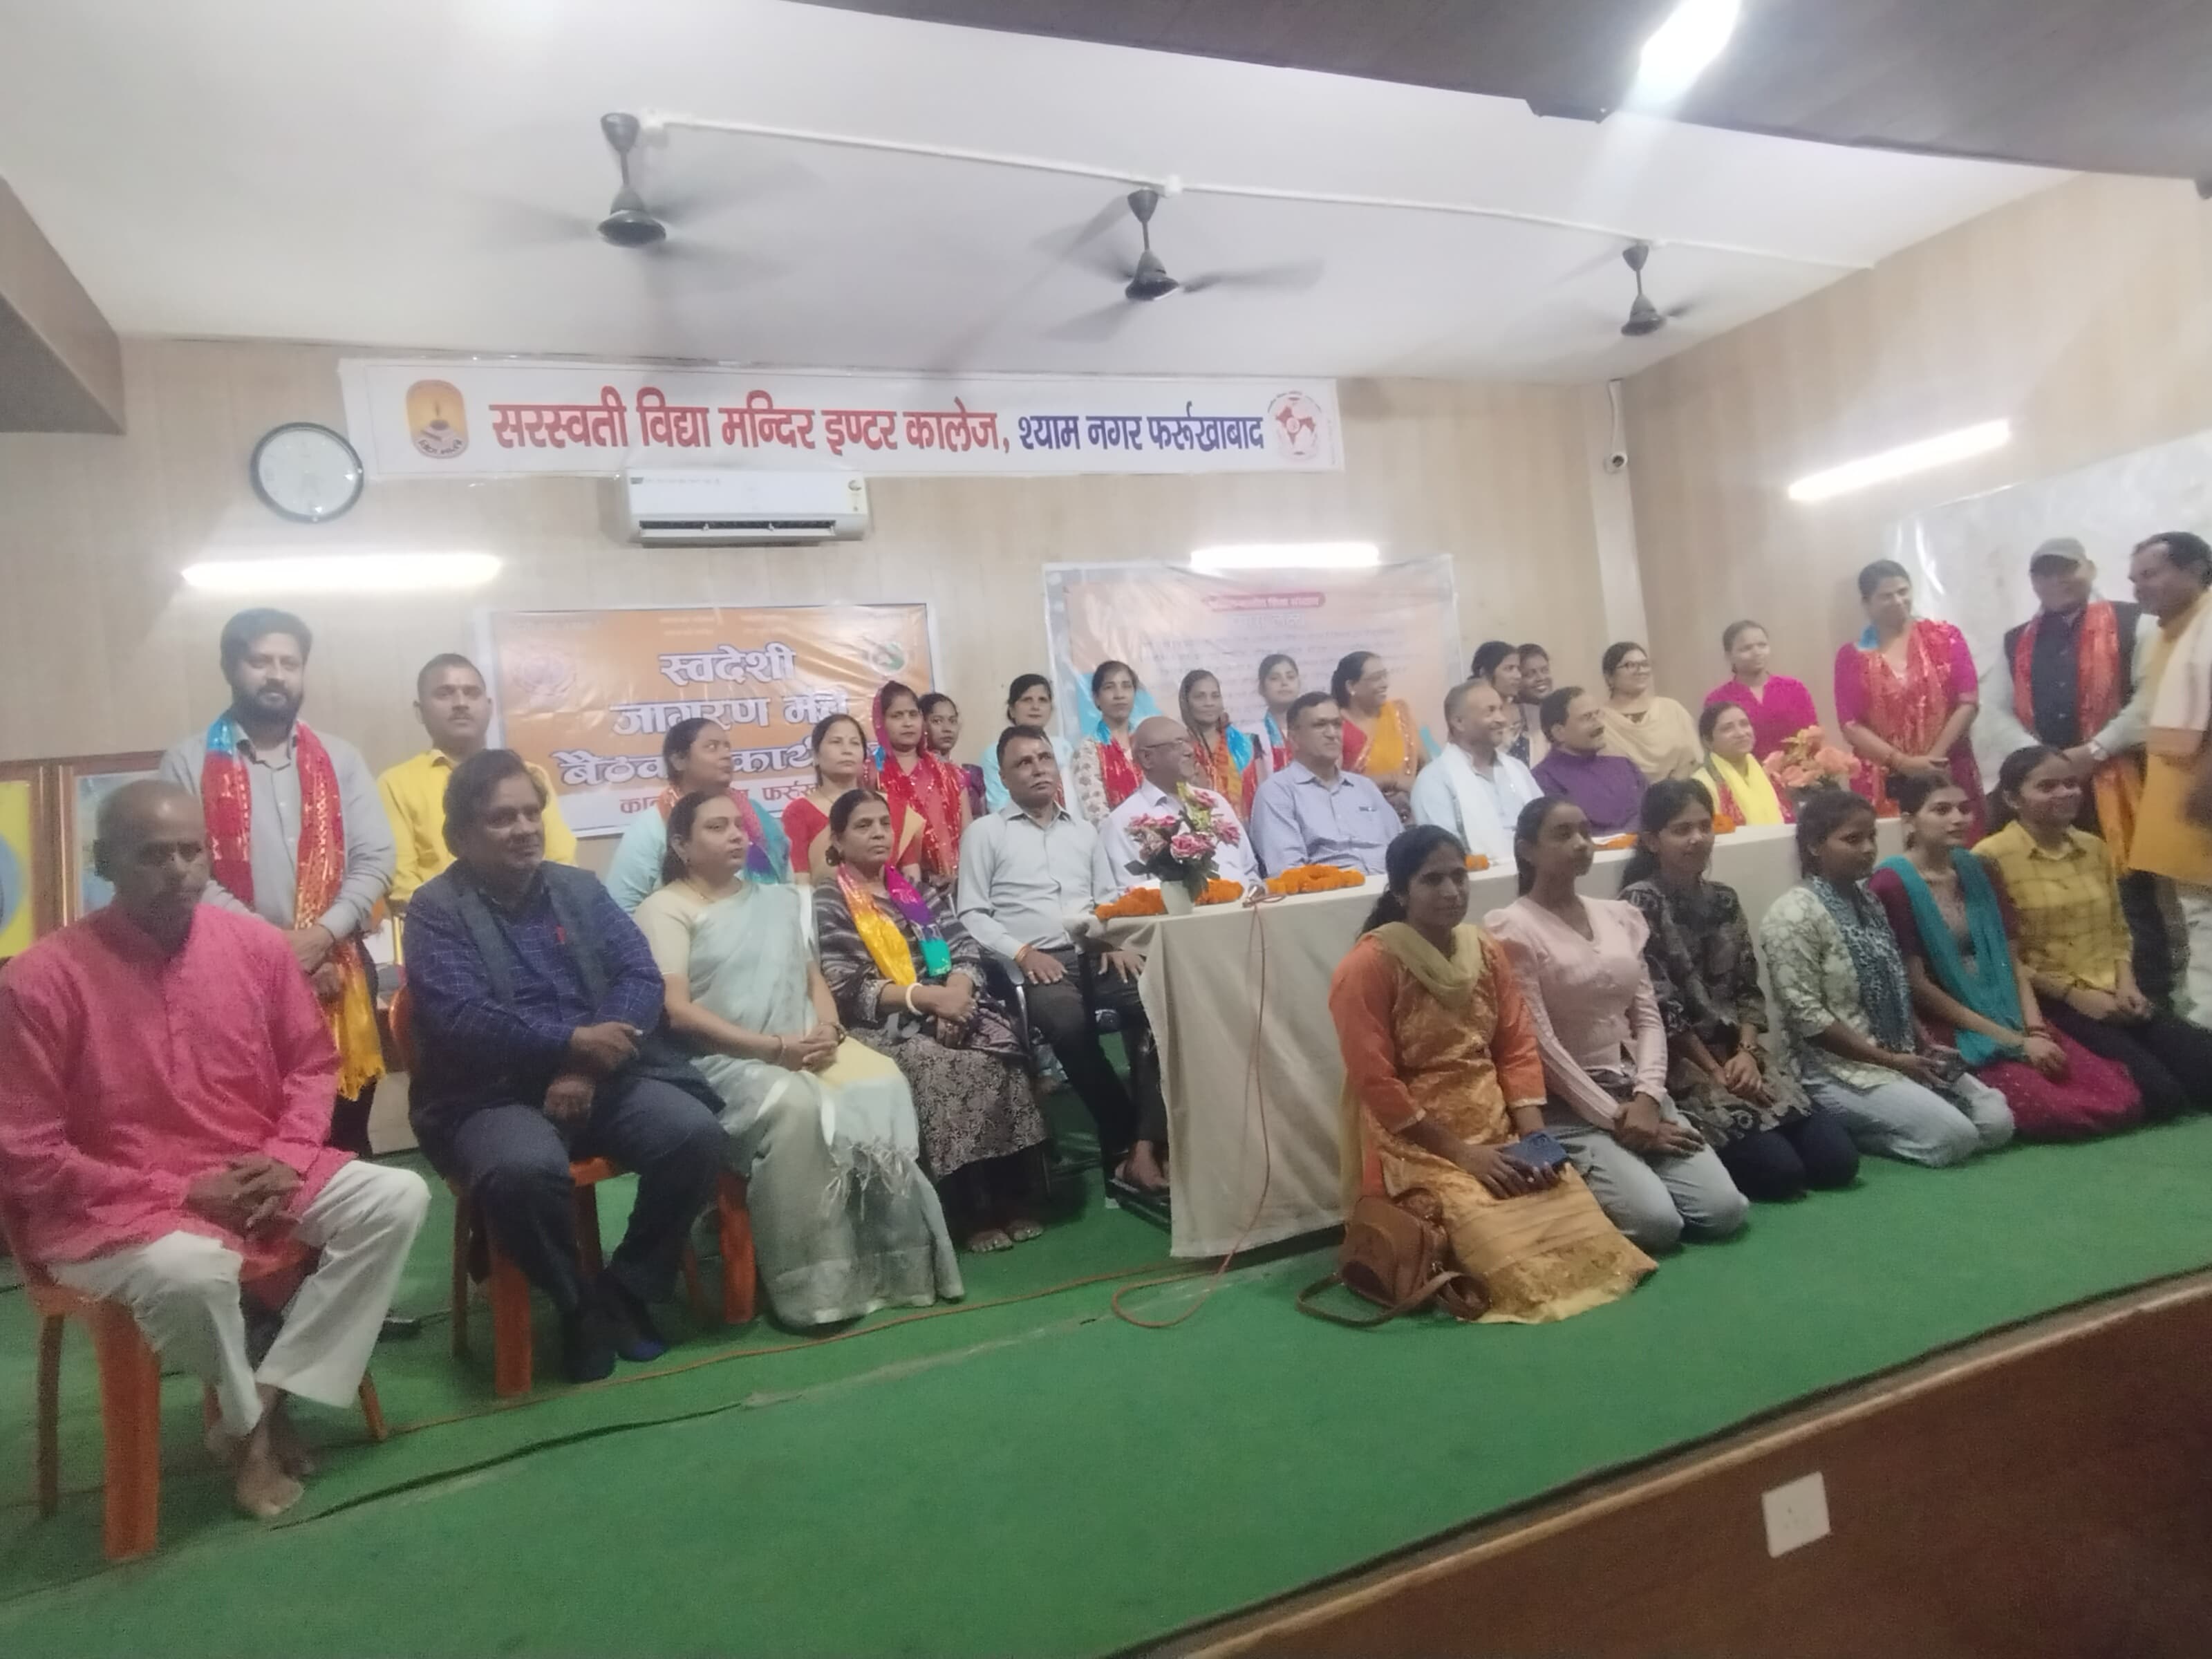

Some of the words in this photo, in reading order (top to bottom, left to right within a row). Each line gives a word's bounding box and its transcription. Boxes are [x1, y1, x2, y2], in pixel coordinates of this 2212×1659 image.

[489, 385, 628, 449] सरस्वती
[636, 386, 711, 447] विद्या
[718, 390, 816, 449] मन्दिर
[821, 410, 897, 456] इण्टर
[903, 396, 1009, 453] कालेज,
[1018, 415, 1080, 450] श्याम
[1086, 415, 1143, 451] नगर
[659, 641, 797, 686] स्वदेशी
[609, 697, 771, 735] जागरण
